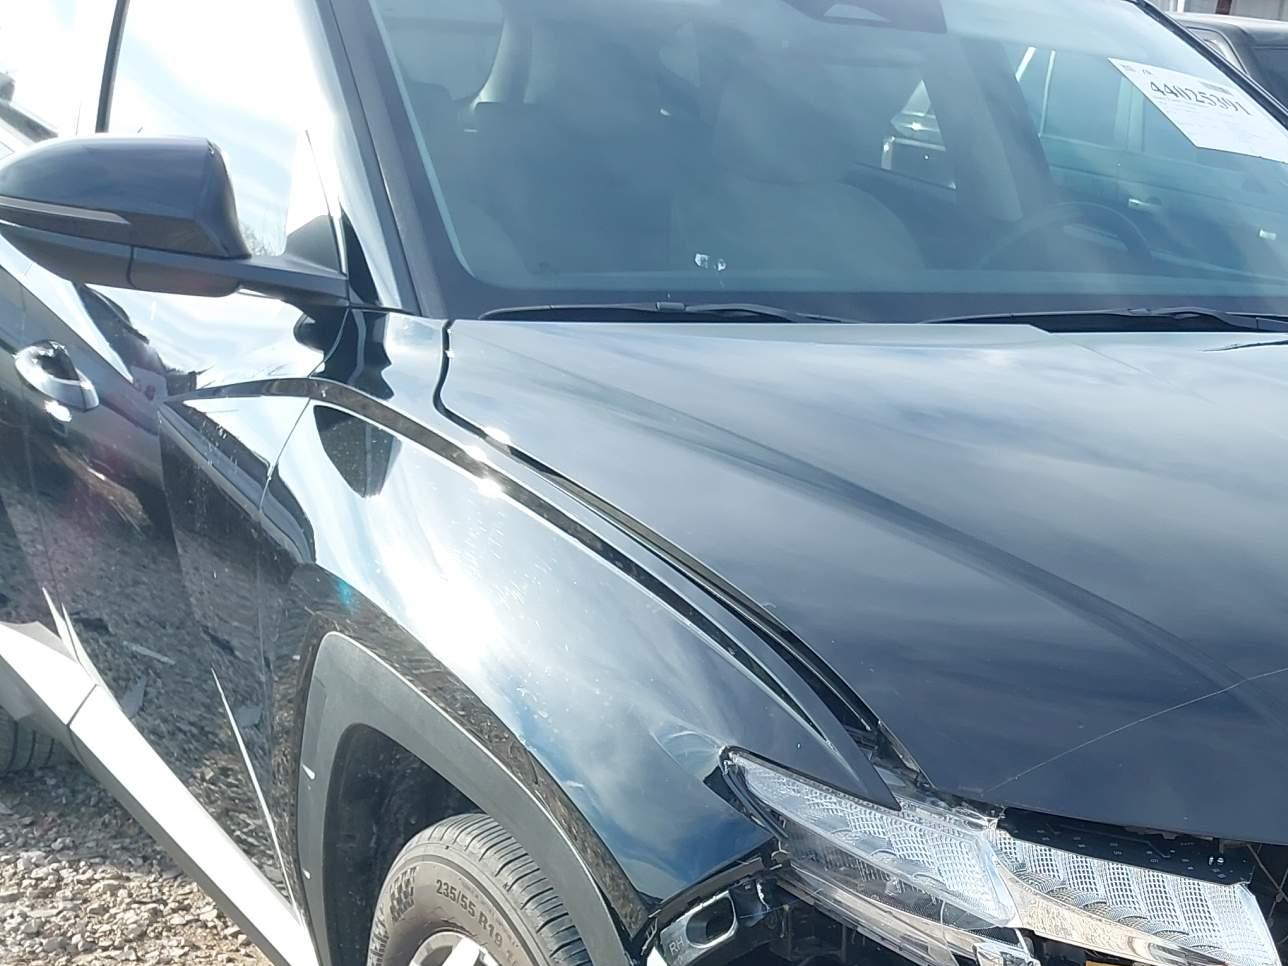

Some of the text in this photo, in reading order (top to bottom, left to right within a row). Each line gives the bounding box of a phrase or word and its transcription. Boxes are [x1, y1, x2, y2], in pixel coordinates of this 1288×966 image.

[436, 880, 476, 918] 235/55
[478, 911, 503, 948] R19
[669, 938, 684, 956] RH
